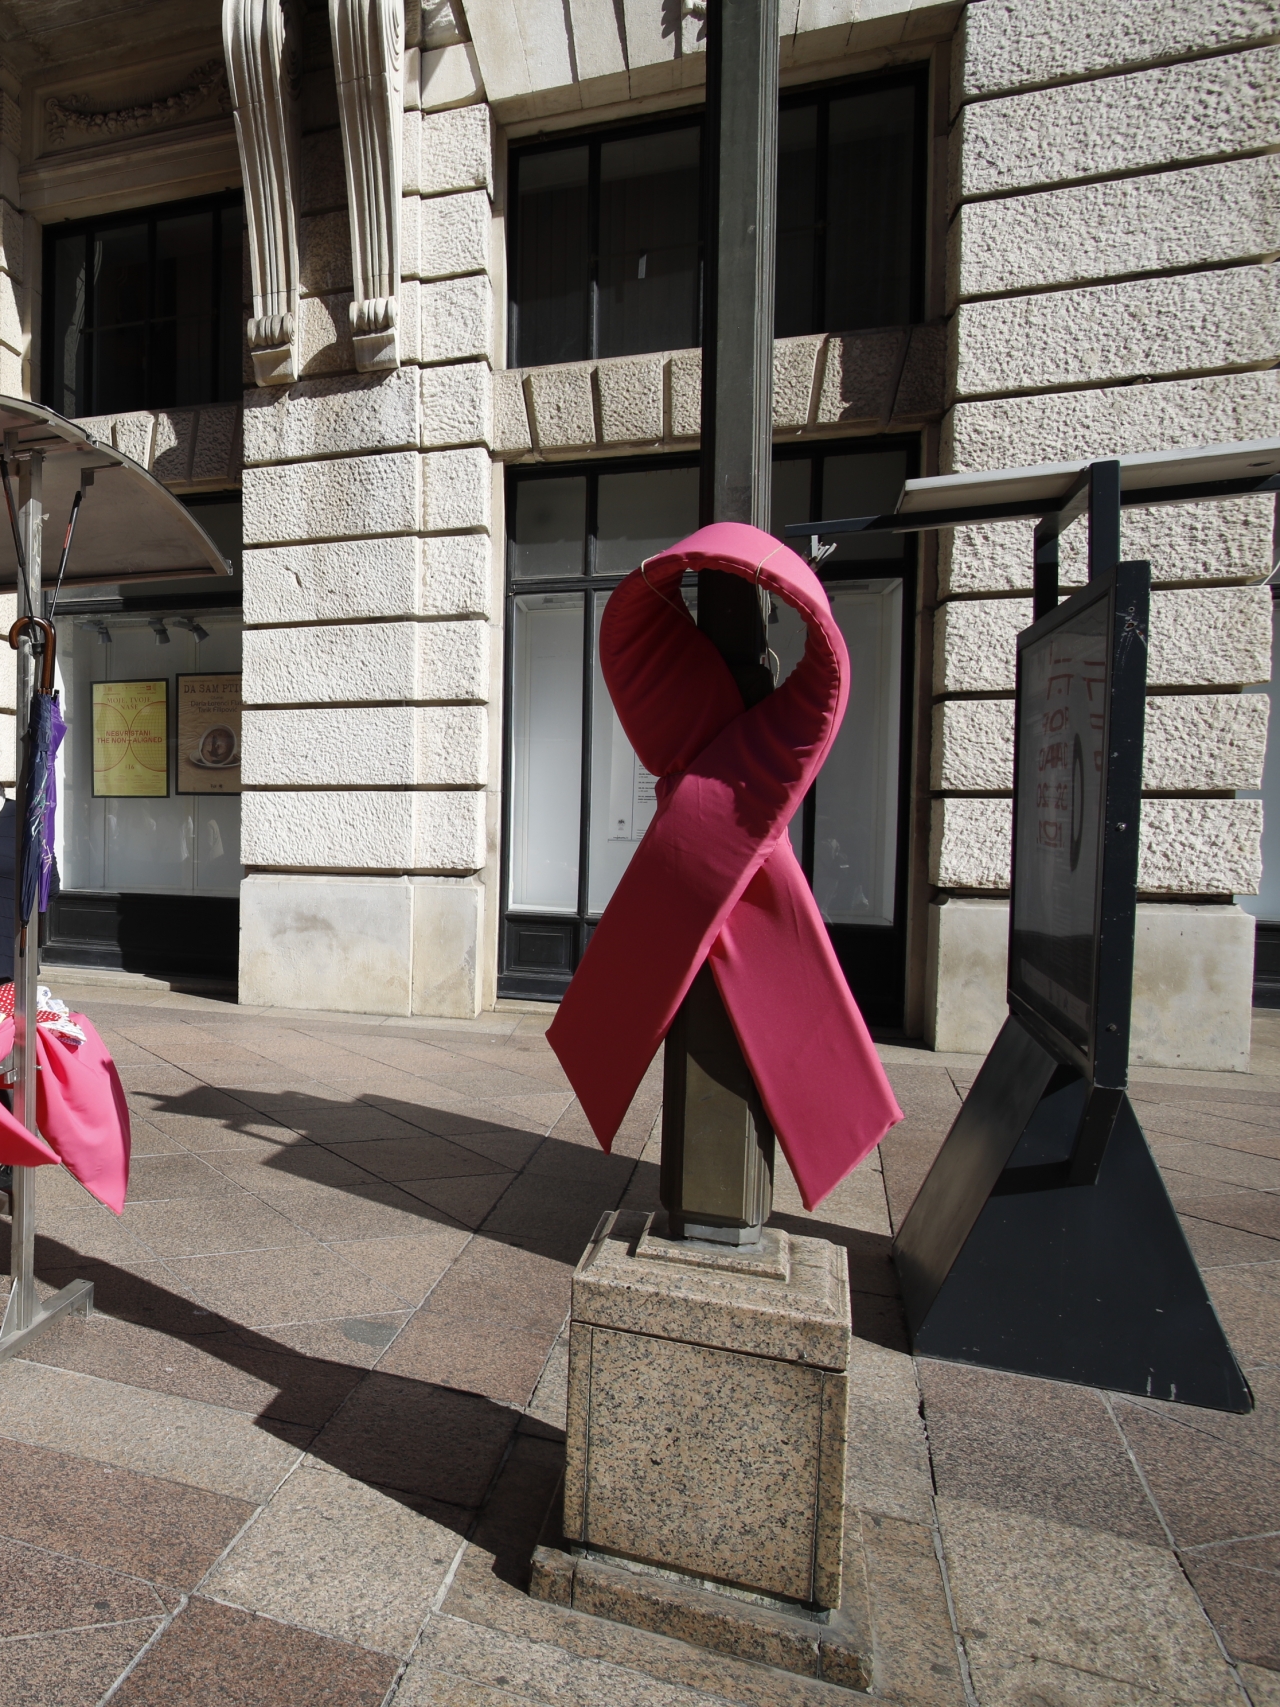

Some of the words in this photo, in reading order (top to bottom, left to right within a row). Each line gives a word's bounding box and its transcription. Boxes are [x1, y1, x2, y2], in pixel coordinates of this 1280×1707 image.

[183, 684, 196, 694] DA
[198, 684, 219, 694] SAM
[222, 683, 242, 693] PTI
